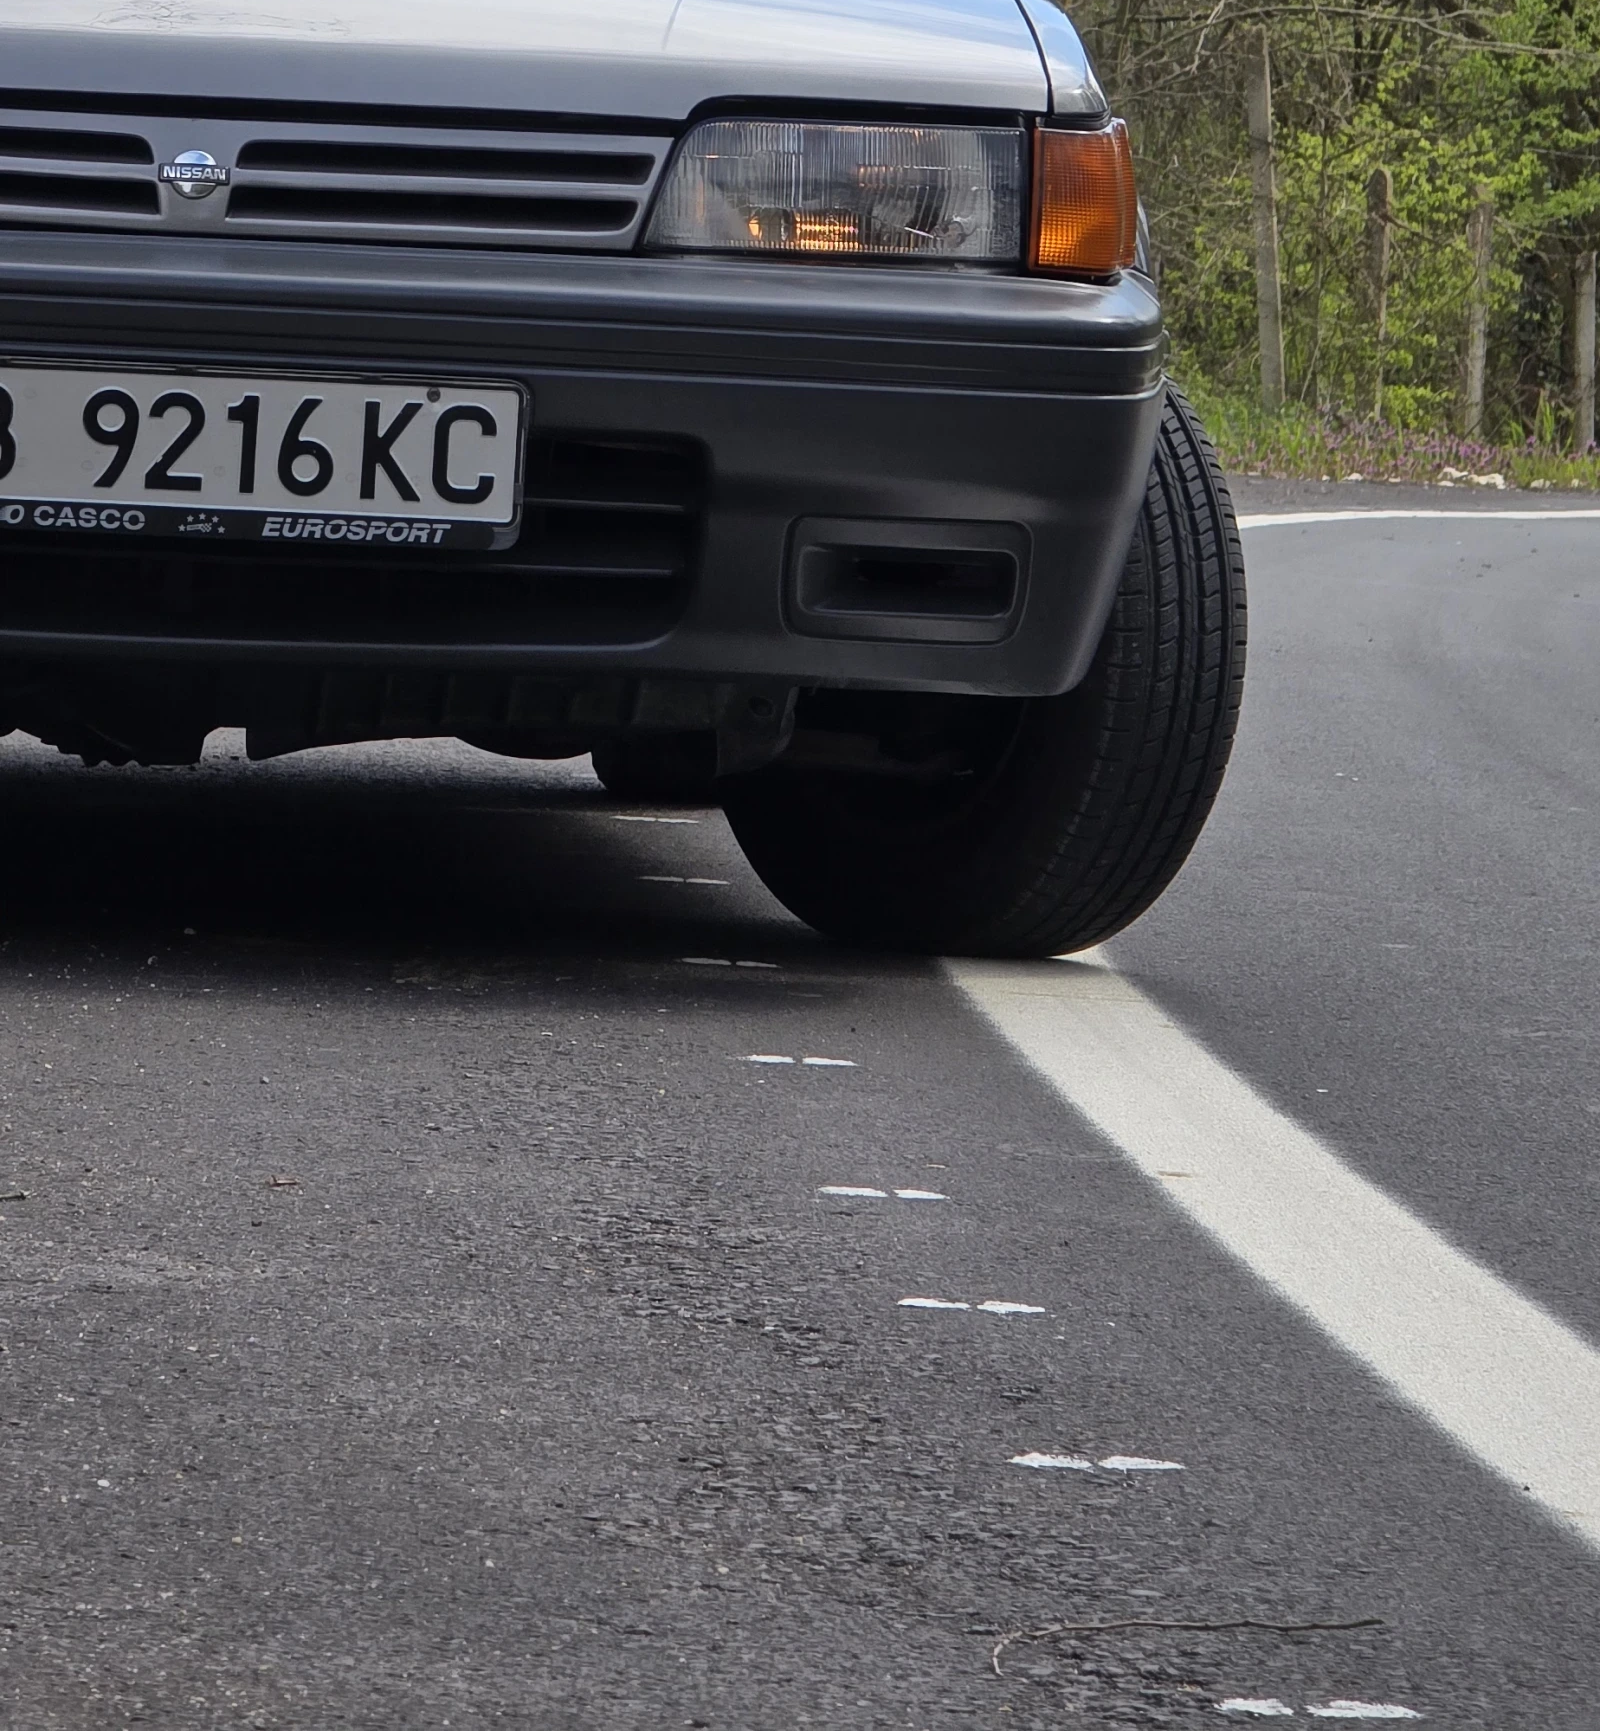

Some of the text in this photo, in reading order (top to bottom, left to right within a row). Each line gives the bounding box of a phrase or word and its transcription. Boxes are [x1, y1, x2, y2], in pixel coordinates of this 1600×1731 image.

[163, 165, 226, 181] NISSAN
[33, 505, 146, 530] CASCO
[261, 517, 451, 544] EUROSPORT
